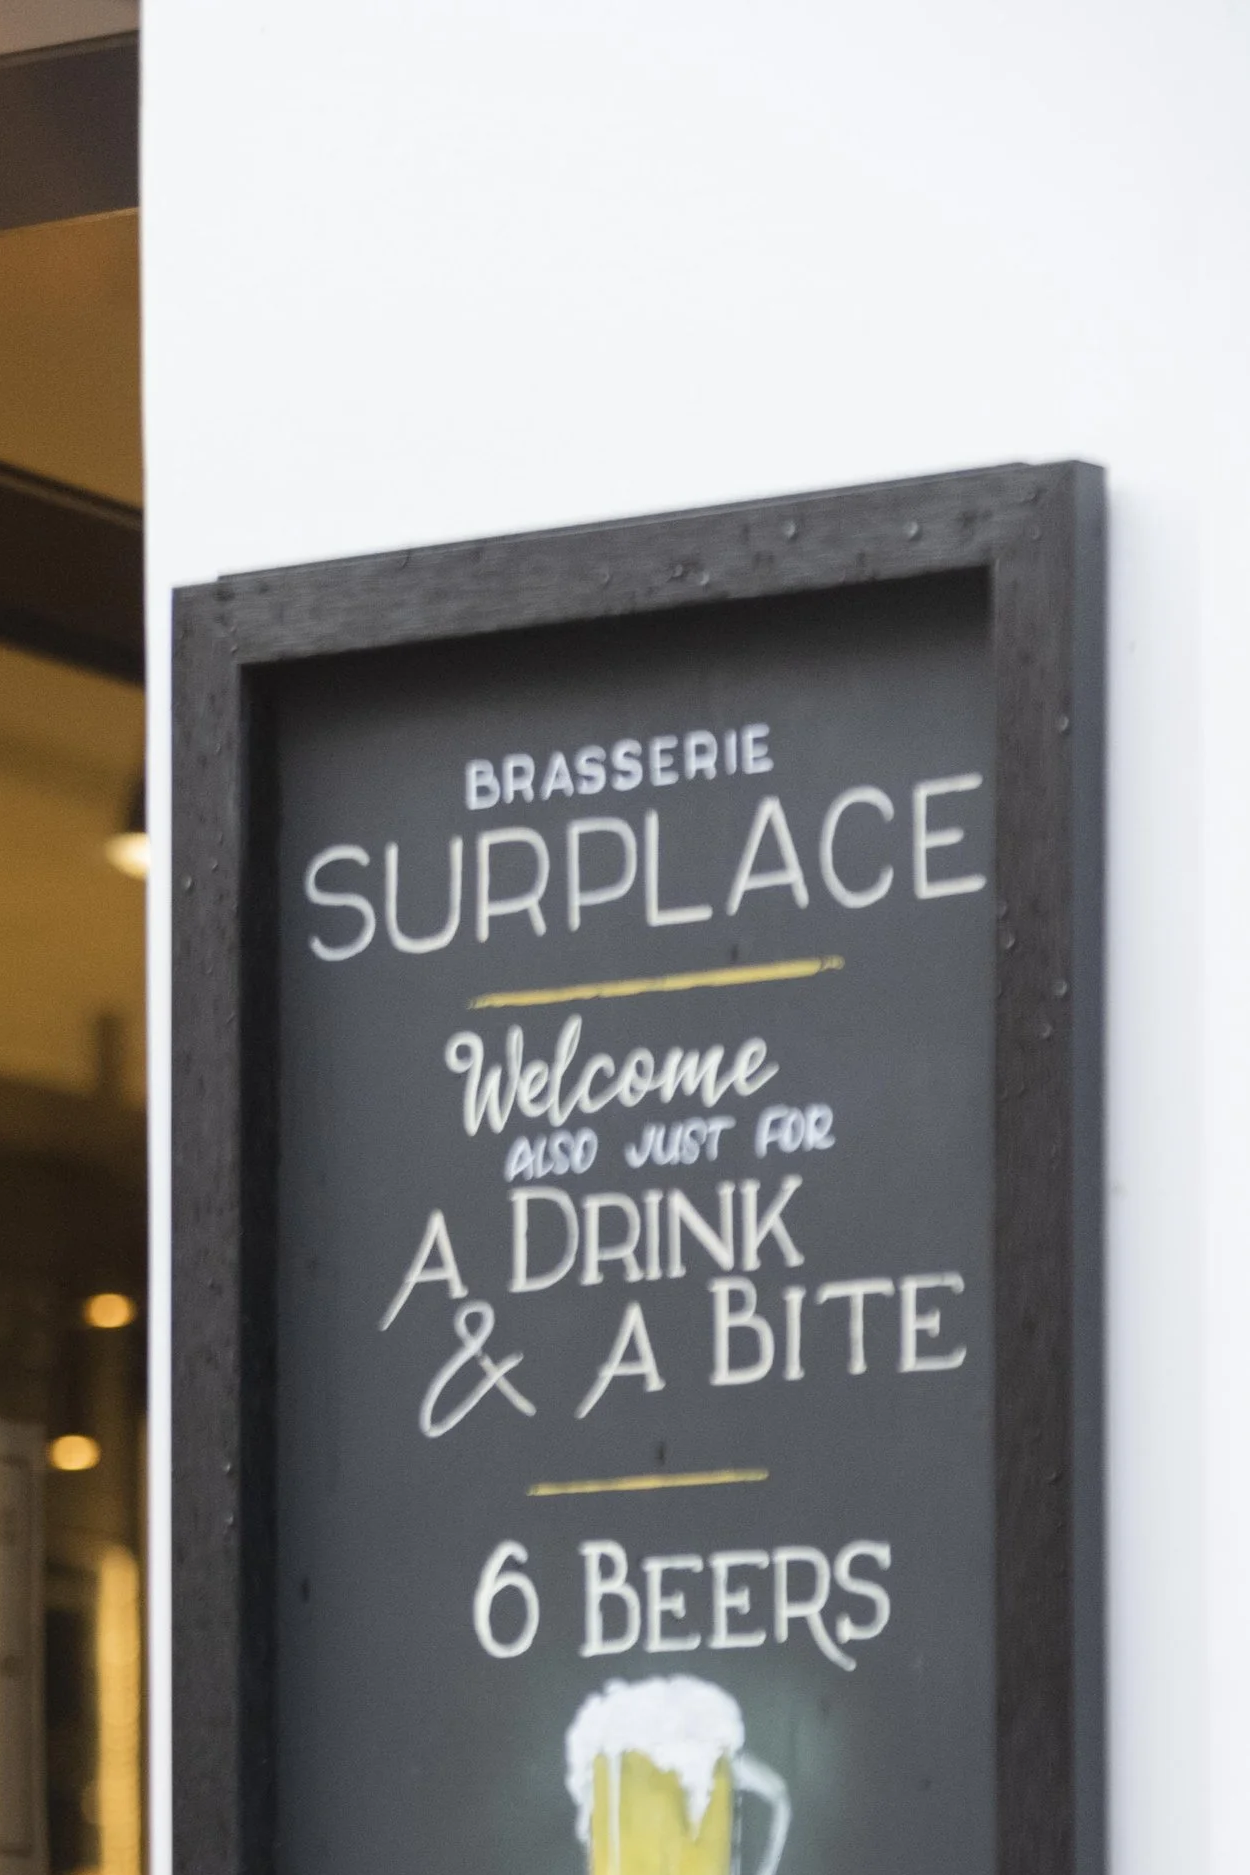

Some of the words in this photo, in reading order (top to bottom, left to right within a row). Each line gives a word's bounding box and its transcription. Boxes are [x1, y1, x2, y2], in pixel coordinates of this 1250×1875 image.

[464, 723, 774, 811] BRASSERIE
[302, 771, 988, 963] SURPLACE
[443, 1014, 780, 1136] Welcome
[505, 1127, 599, 1183] ALSO
[625, 1114, 736, 1169] JUST
[754, 1103, 837, 1158] FOR
[378, 1208, 469, 1332] A
[508, 1174, 806, 1294] DRINK
[418, 1301, 538, 1439] &
[574, 1301, 667, 1420] A
[708, 1271, 967, 1387] BITE
[472, 1540, 541, 1660] 6
[578, 1540, 893, 1672] BEERS
